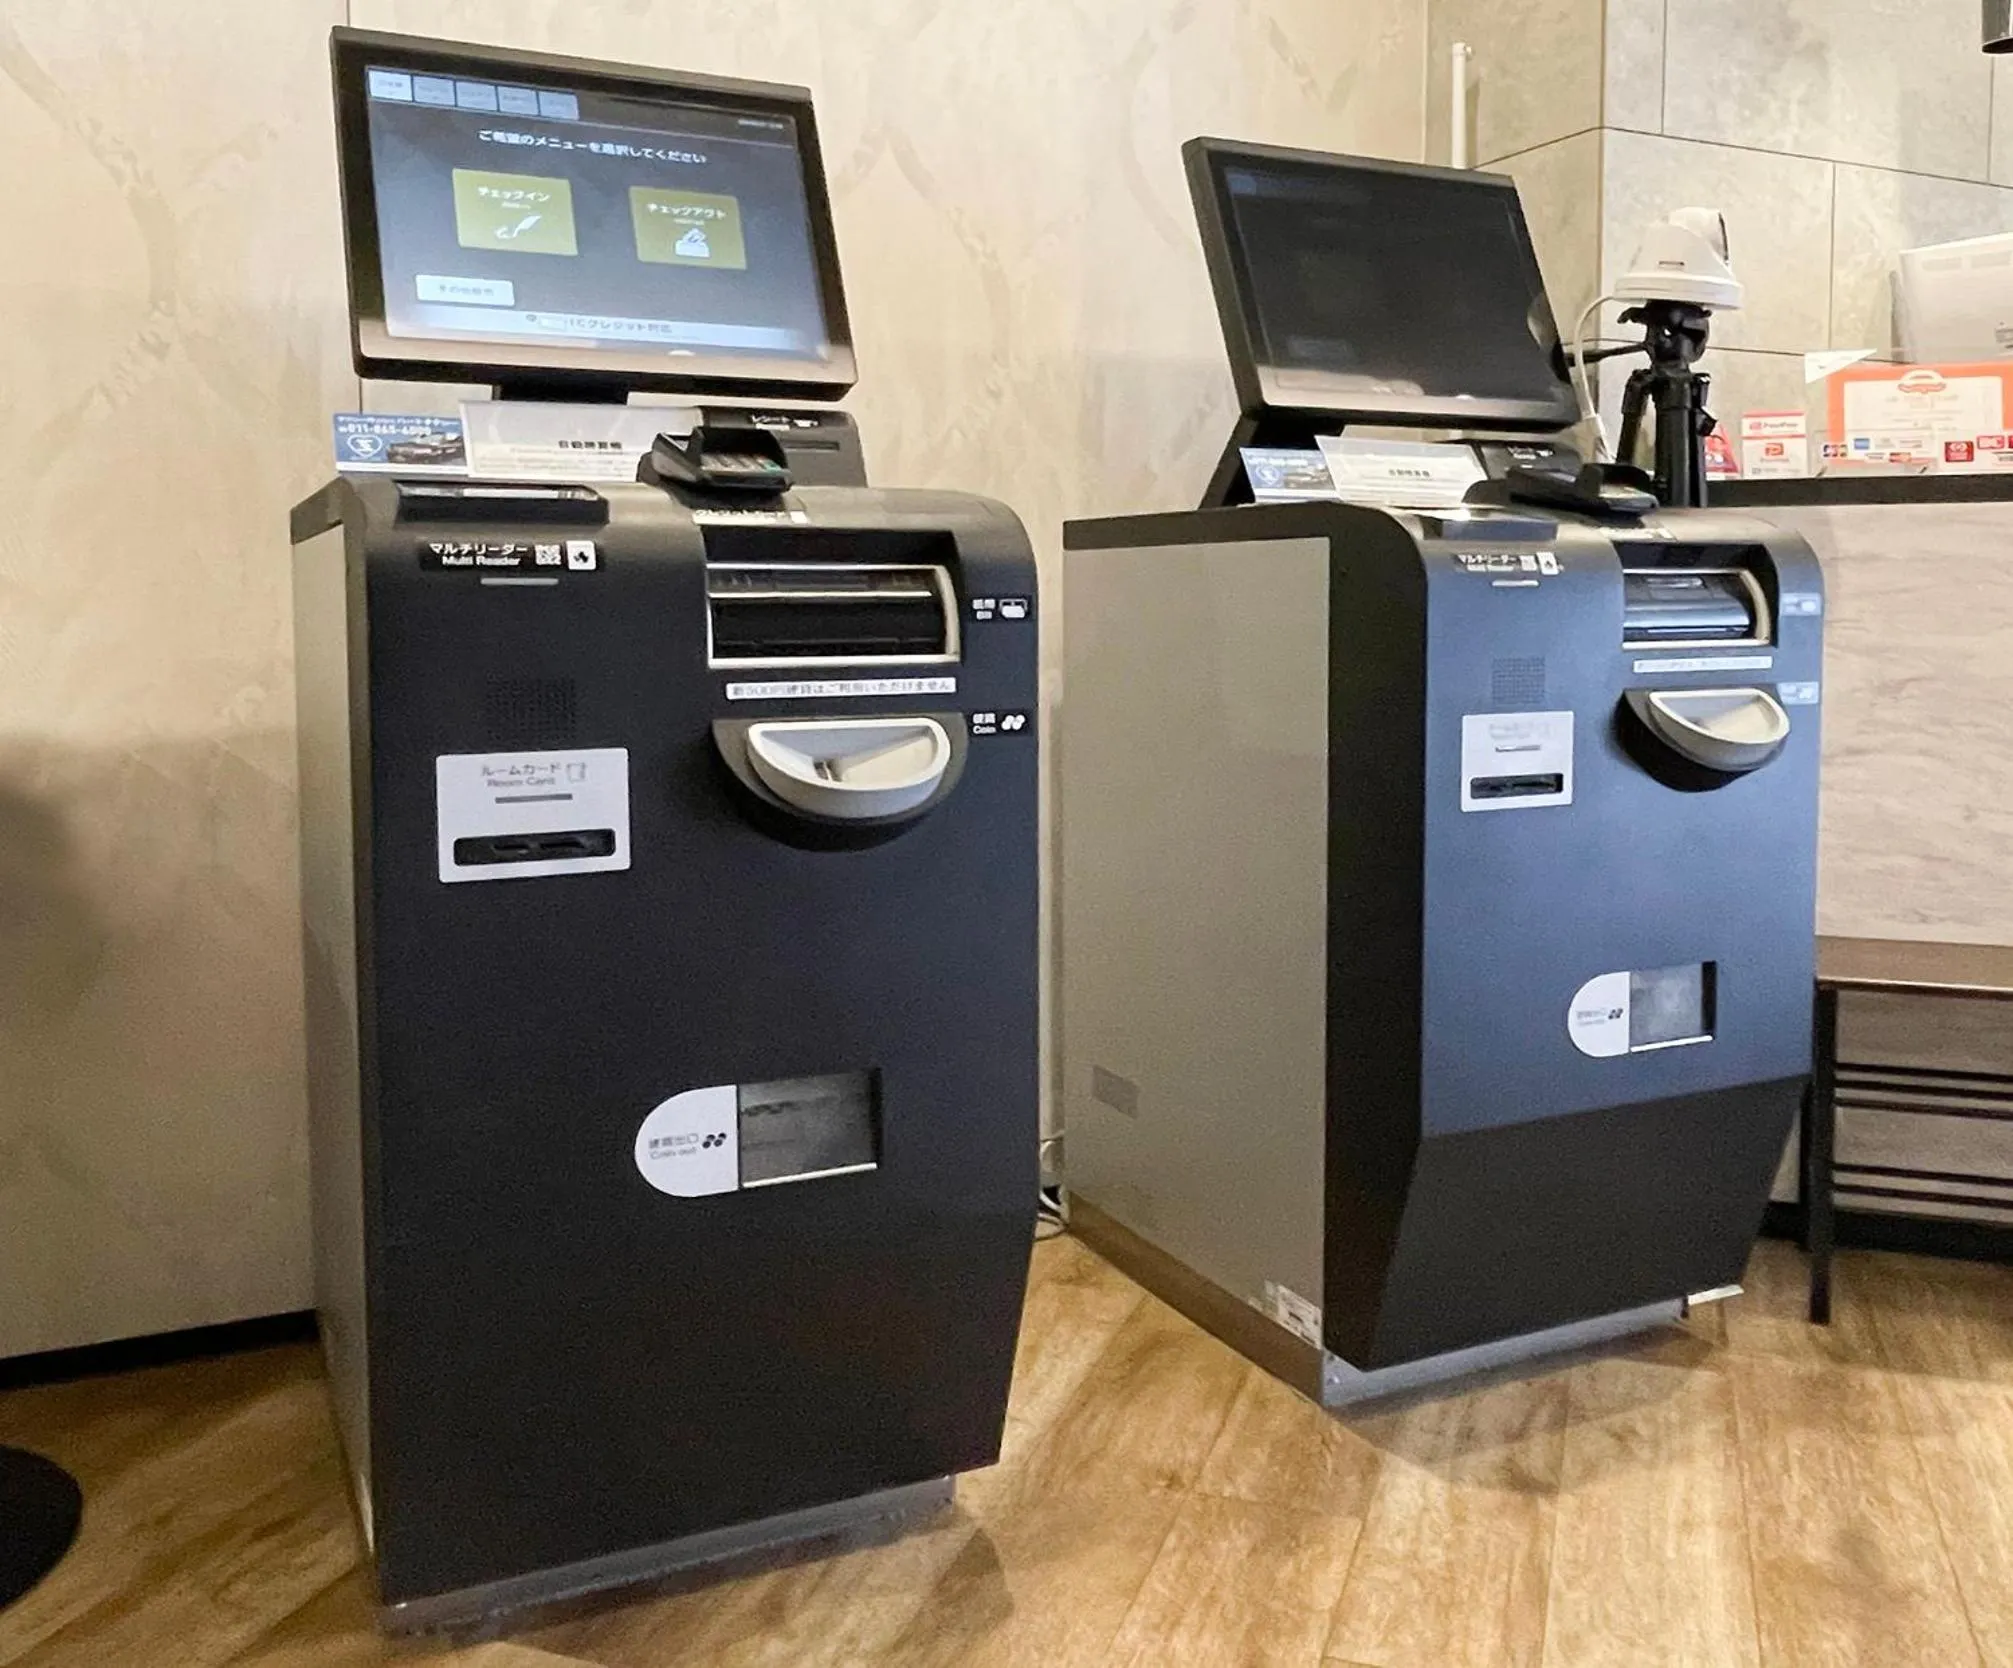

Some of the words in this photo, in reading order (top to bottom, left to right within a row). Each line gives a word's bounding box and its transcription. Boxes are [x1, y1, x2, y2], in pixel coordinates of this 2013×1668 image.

[478, 129, 707, 164] ご希望のメニューを選択してください
[477, 186, 551, 202] チェックイン
[646, 202, 727, 220] チェックアウト
[428, 542, 529, 556] マルチリーダー
[442, 555, 474, 566] Multi
[476, 555, 521, 566] Reader
[481, 763, 562, 777] ルームカード
